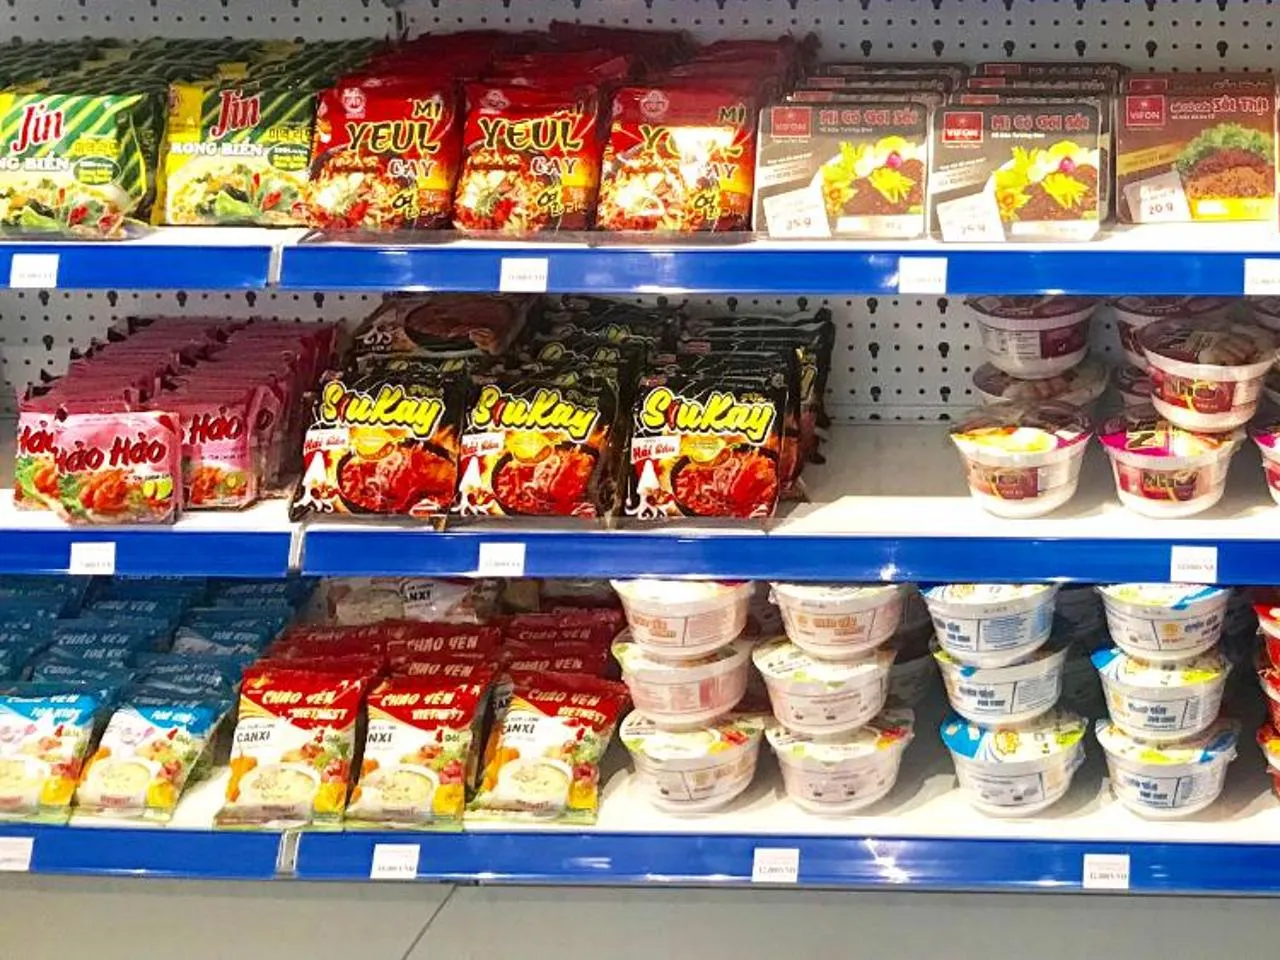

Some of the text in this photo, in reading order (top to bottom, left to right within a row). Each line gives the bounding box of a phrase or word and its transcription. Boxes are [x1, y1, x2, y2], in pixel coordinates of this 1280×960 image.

[13, 102, 65, 154] Jin
[212, 87, 260, 137] Jin
[1131, 110, 1162, 121] VIFON
[347, 121, 441, 153] YEUL
[478, 118, 584, 152] YEUL
[109, 431, 167, 467] Hảo
[236, 731, 272, 744] CANXI
